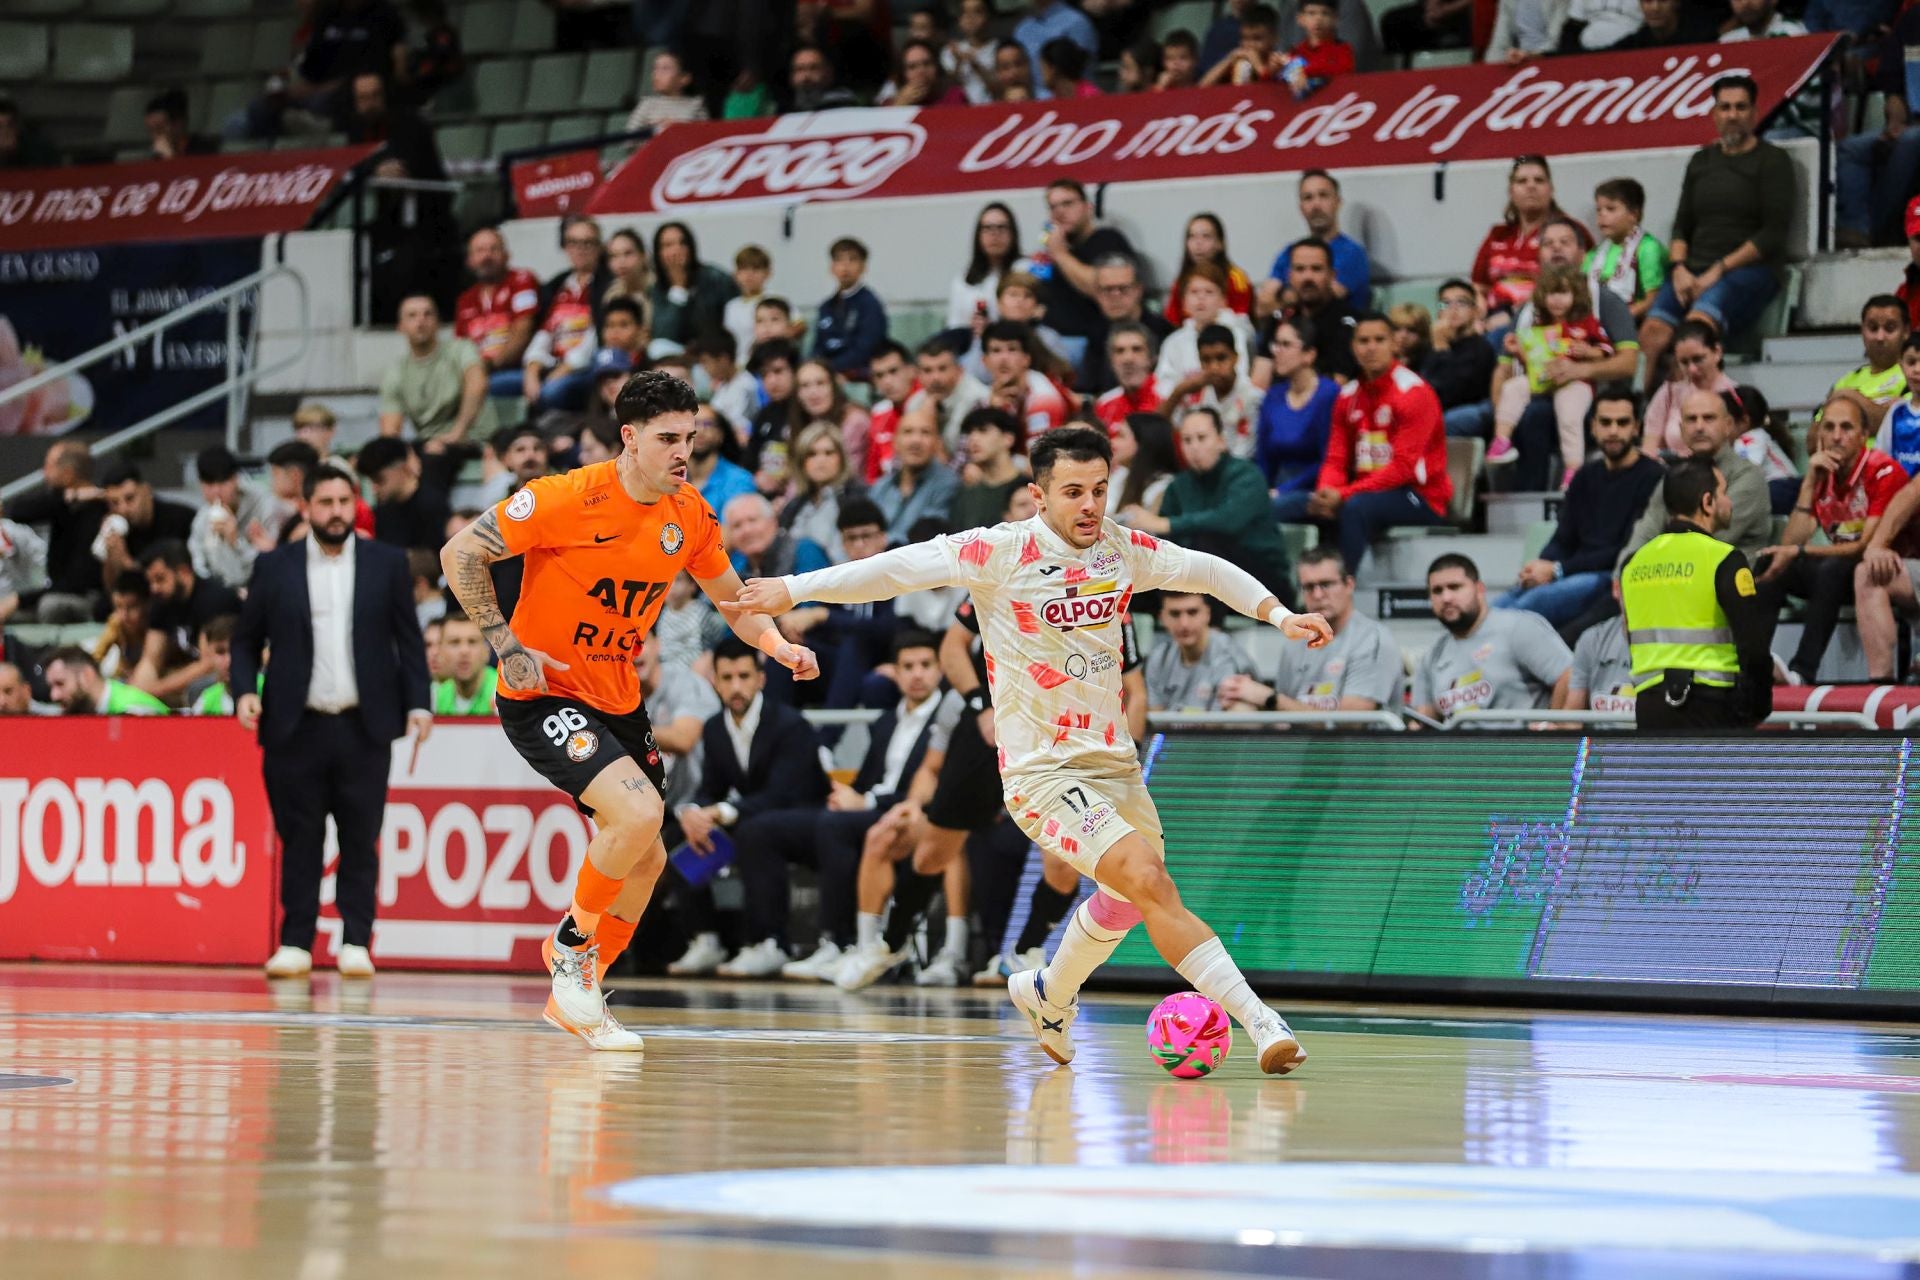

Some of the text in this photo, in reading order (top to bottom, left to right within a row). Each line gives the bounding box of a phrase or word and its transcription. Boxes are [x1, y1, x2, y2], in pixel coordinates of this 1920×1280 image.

[959, 110, 1122, 172] Uno
[1274, 92, 1378, 150] de
[1374, 85, 1461, 142] la
[543, 707, 588, 746] 96
[1061, 786, 1090, 814] 17
